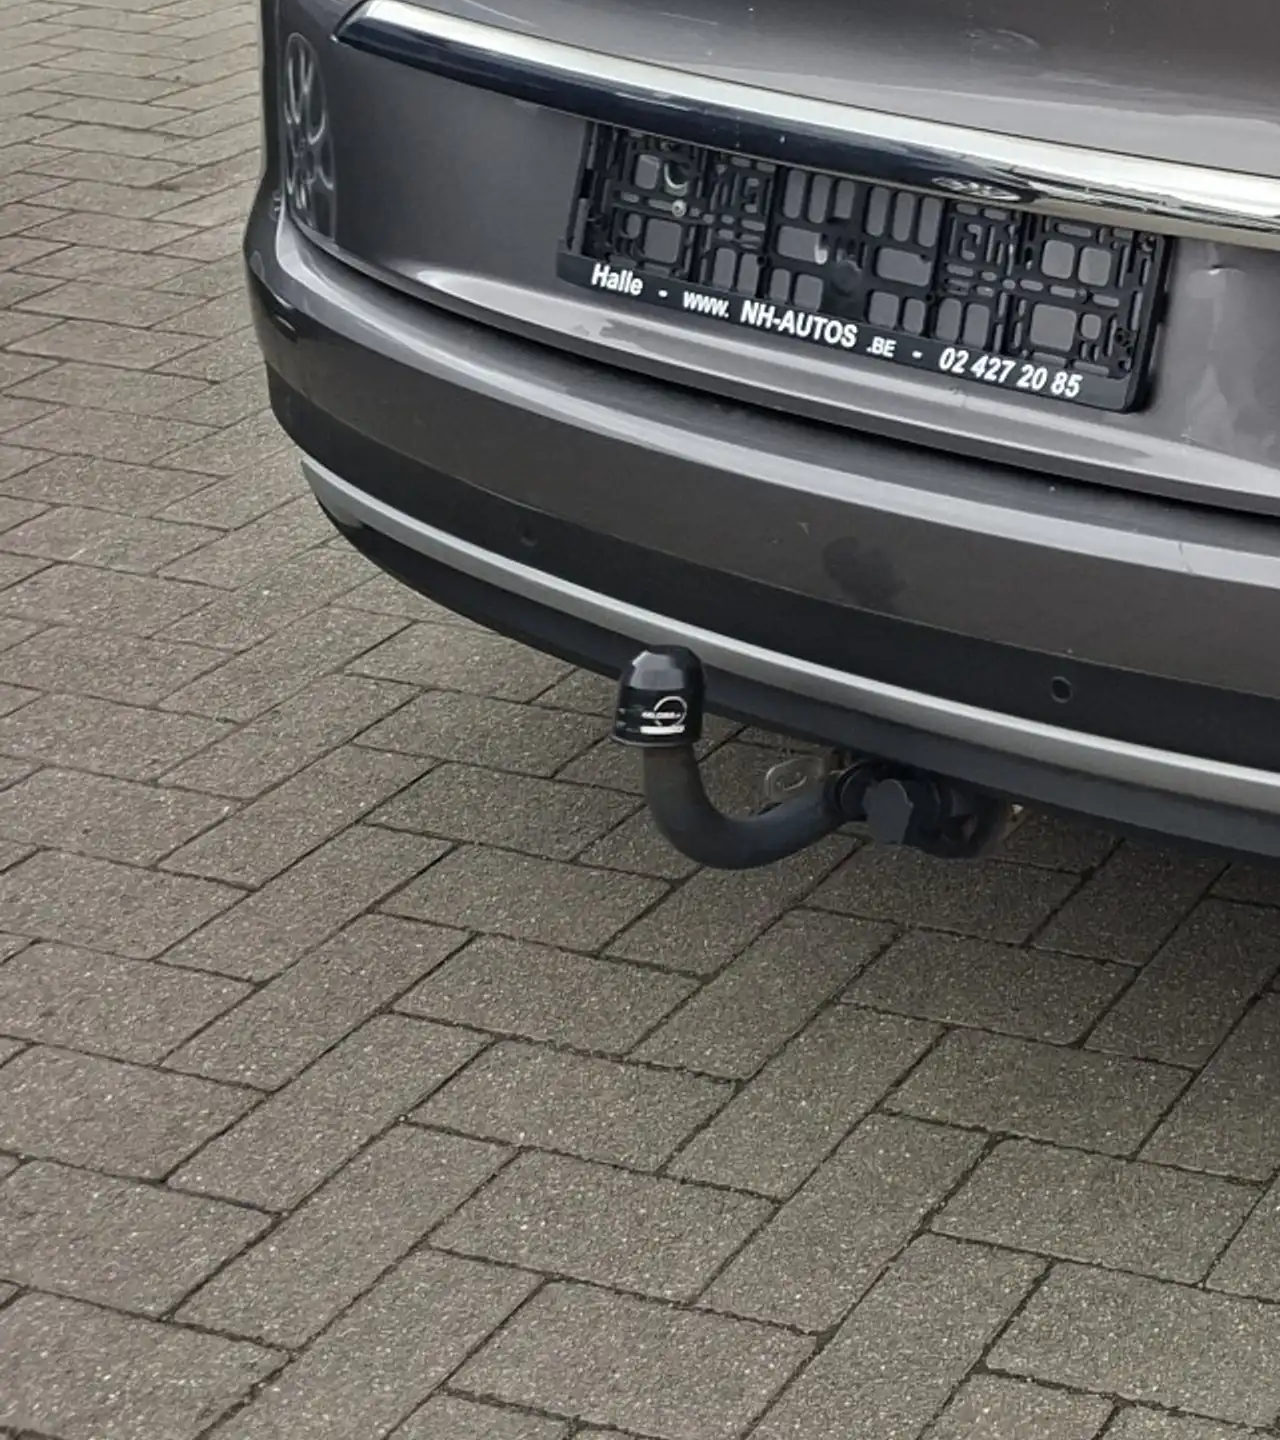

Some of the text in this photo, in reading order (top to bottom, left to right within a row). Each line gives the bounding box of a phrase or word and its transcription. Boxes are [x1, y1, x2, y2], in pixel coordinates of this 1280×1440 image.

[591, 263, 643, 296] Halle
[683, 291, 729, 318] www.
[740, 299, 858, 348] NH-AUTOS
[866, 336, 897, 358] .BE
[938, 347, 969, 374] 02
[970, 355, 1017, 383] 427
[1016, 363, 1048, 391] 20
[1050, 371, 1084, 398] 85
